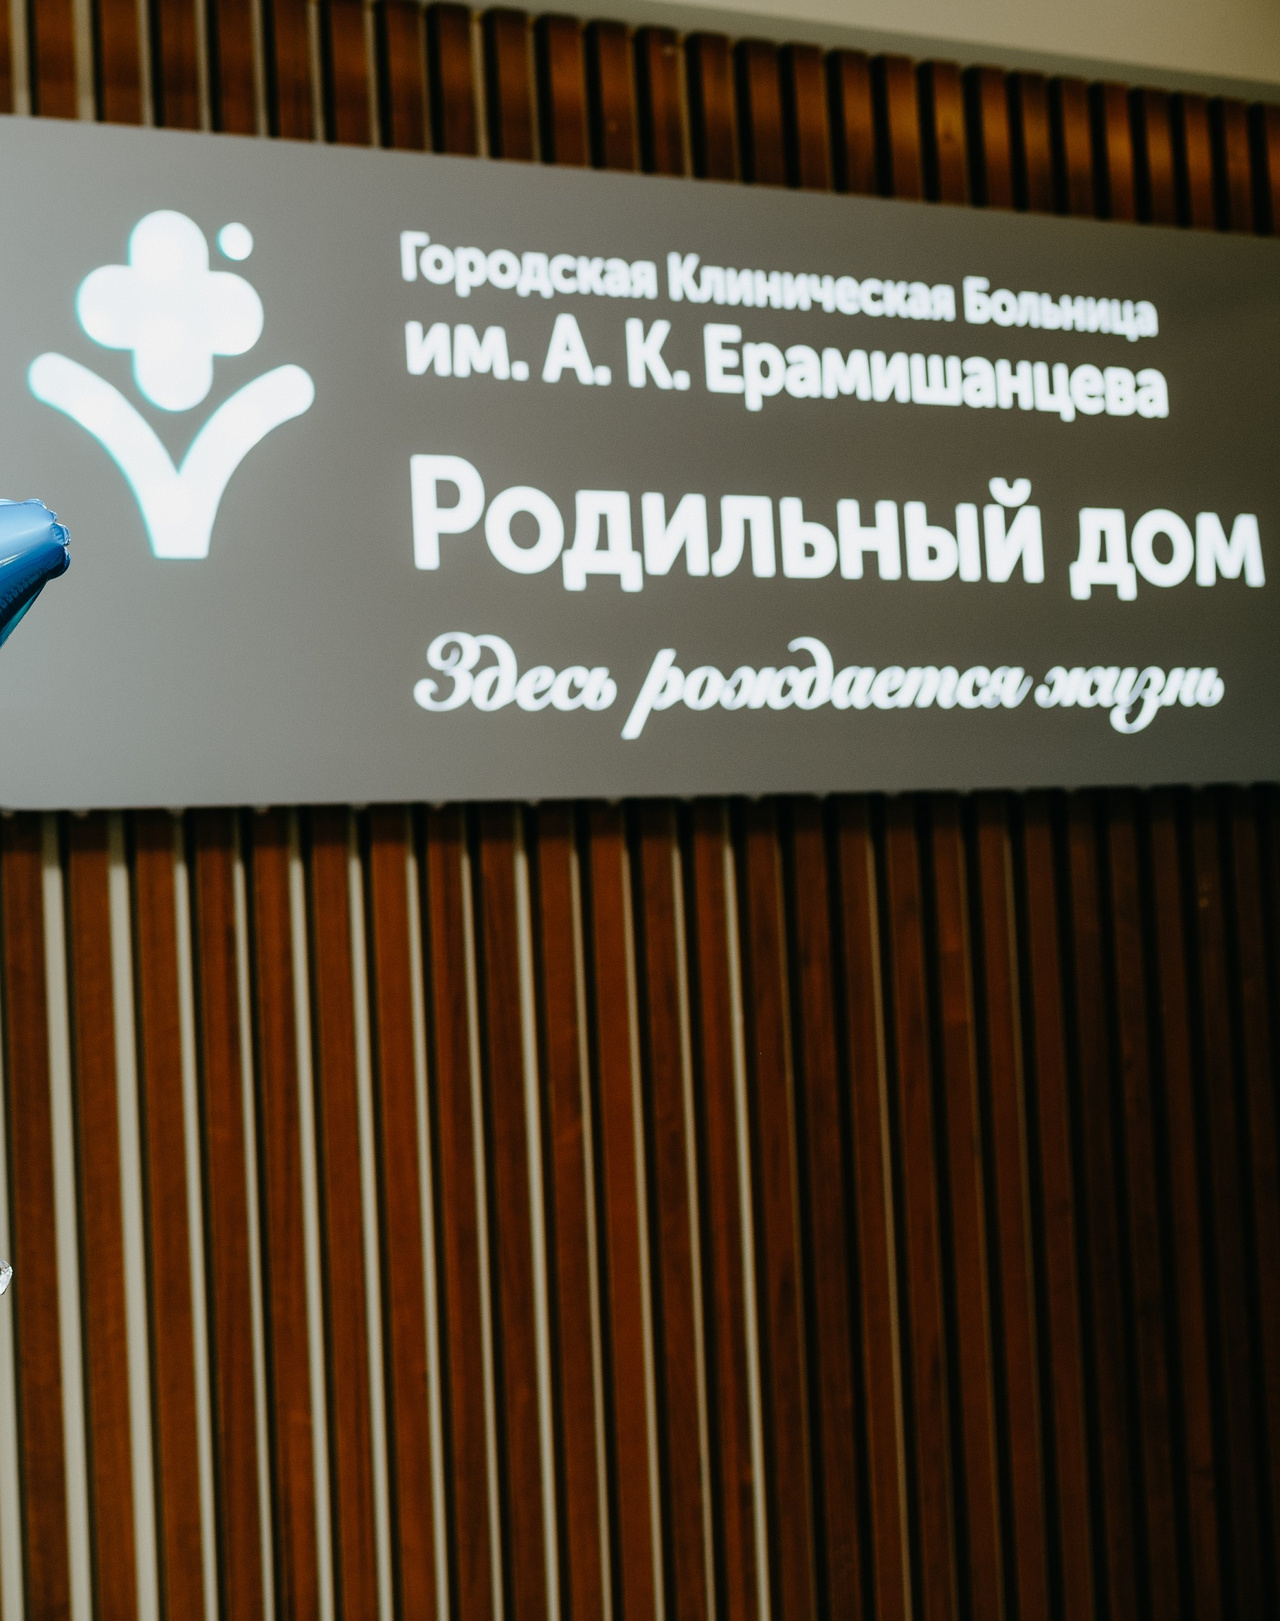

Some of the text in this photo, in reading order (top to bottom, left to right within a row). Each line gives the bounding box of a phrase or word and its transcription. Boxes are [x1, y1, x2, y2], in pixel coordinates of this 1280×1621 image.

[399, 230, 1160, 342] Городская Клиническая Больница
[404, 313, 1170, 422] им. А. К. Ерамишанцева
[409, 453, 1266, 601] Родильный дом
[412, 630, 1226, 741] Здесь рождается жизнь
